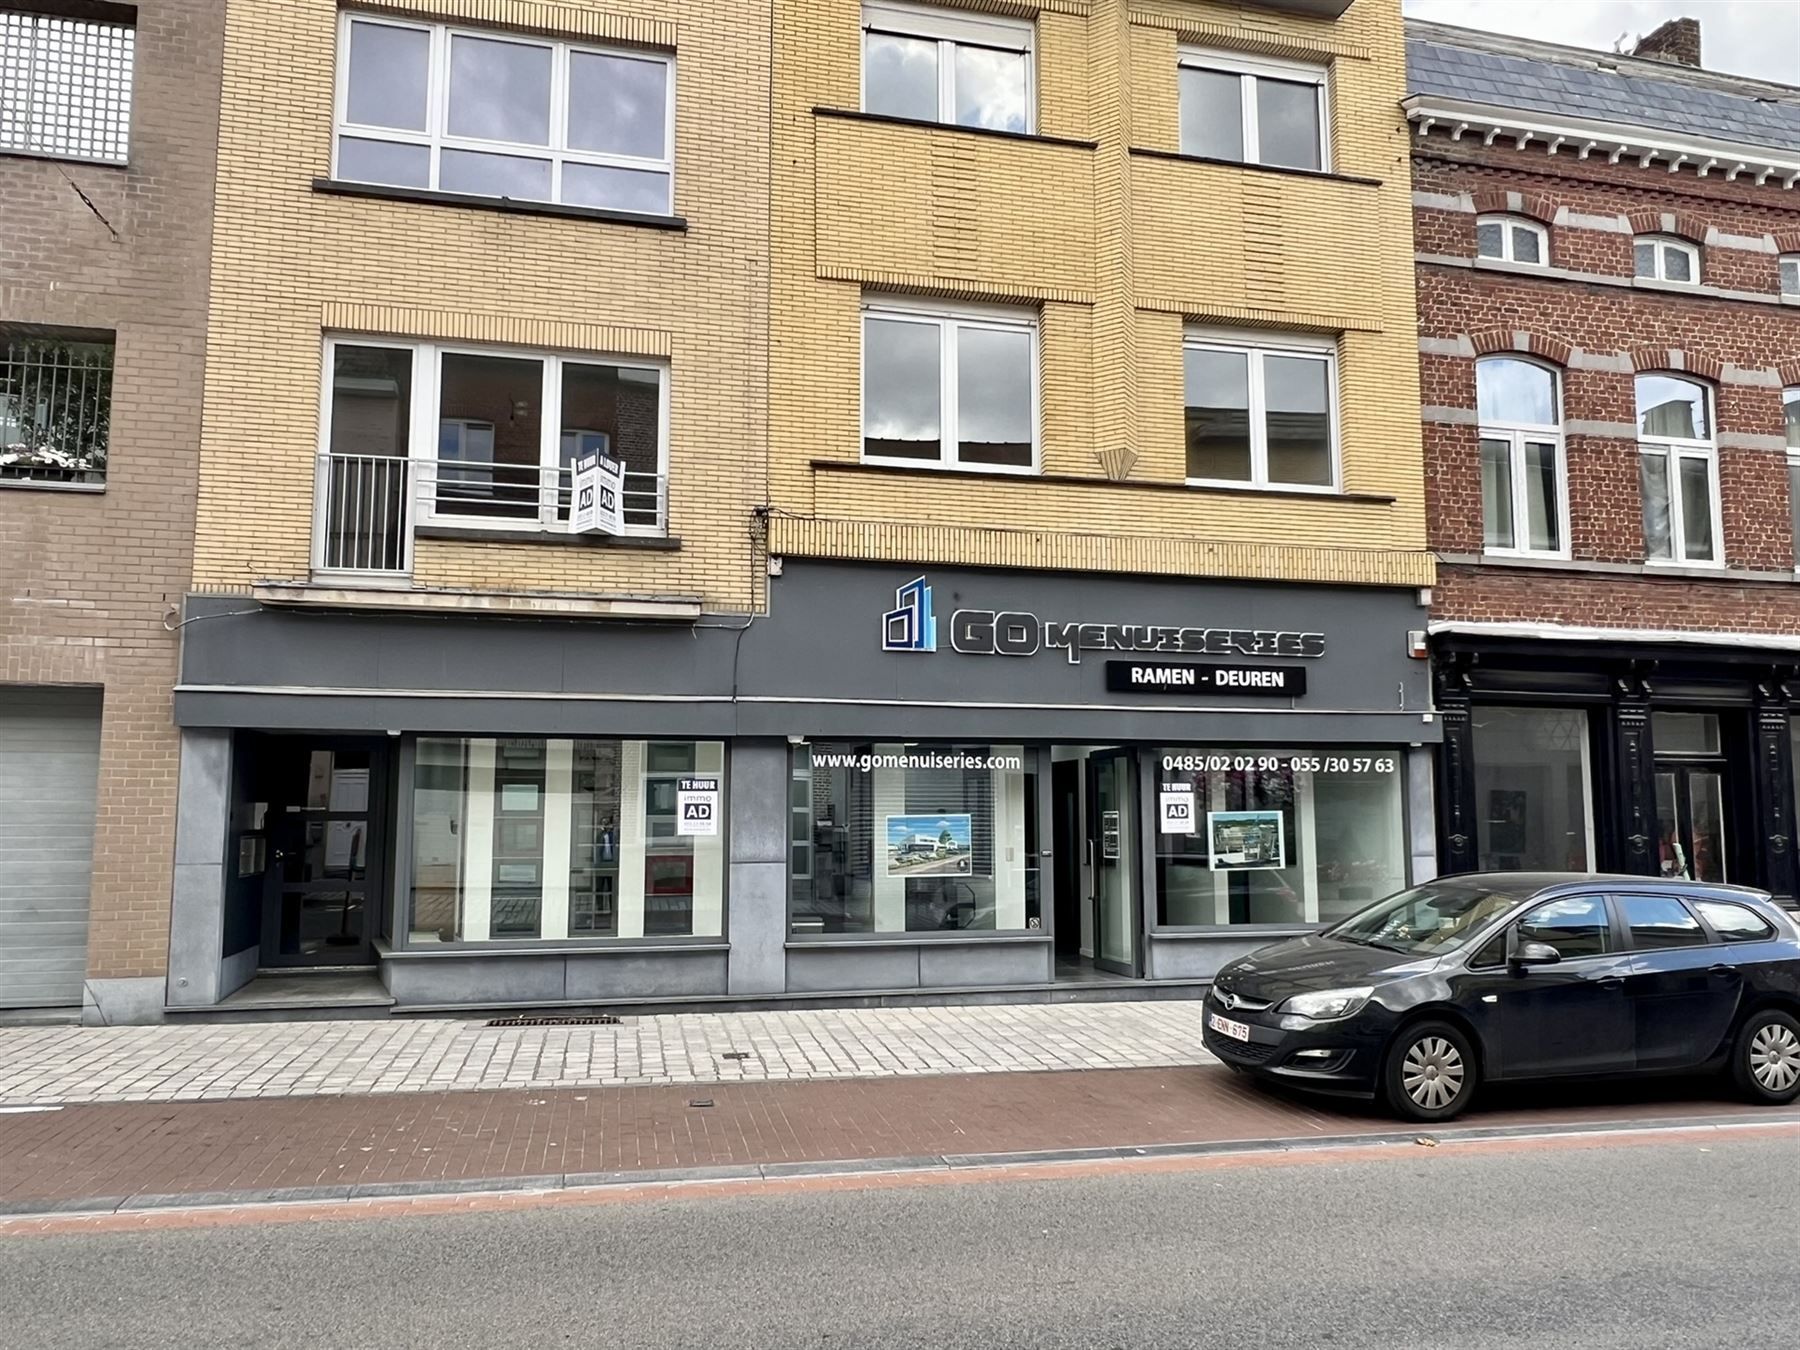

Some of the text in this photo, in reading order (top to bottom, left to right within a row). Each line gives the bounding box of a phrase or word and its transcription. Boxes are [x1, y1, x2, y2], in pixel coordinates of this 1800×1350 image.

[580, 488, 593, 509] AD
[602, 488, 615, 509] AD
[951, 609, 1040, 656] GO
[1131, 667, 1195, 686] RAMEN
[1215, 669, 1285, 687] DEUREN
[812, 751, 1021, 773] www.gomenuiseries.com
[1162, 755, 1231, 773] 0485/02
[1233, 756, 1255, 772] 02
[1258, 757, 1278, 772] 90
[1290, 756, 1321, 772] 055
[1352, 758, 1372, 773] 57
[1374, 758, 1395, 773] 63
[681, 780, 716, 790] TE HUUR
[1162, 783, 1171, 791] TE
[684, 793, 712, 802] immo
[686, 805, 710, 819] AD
[1168, 805, 1188, 818] AD
